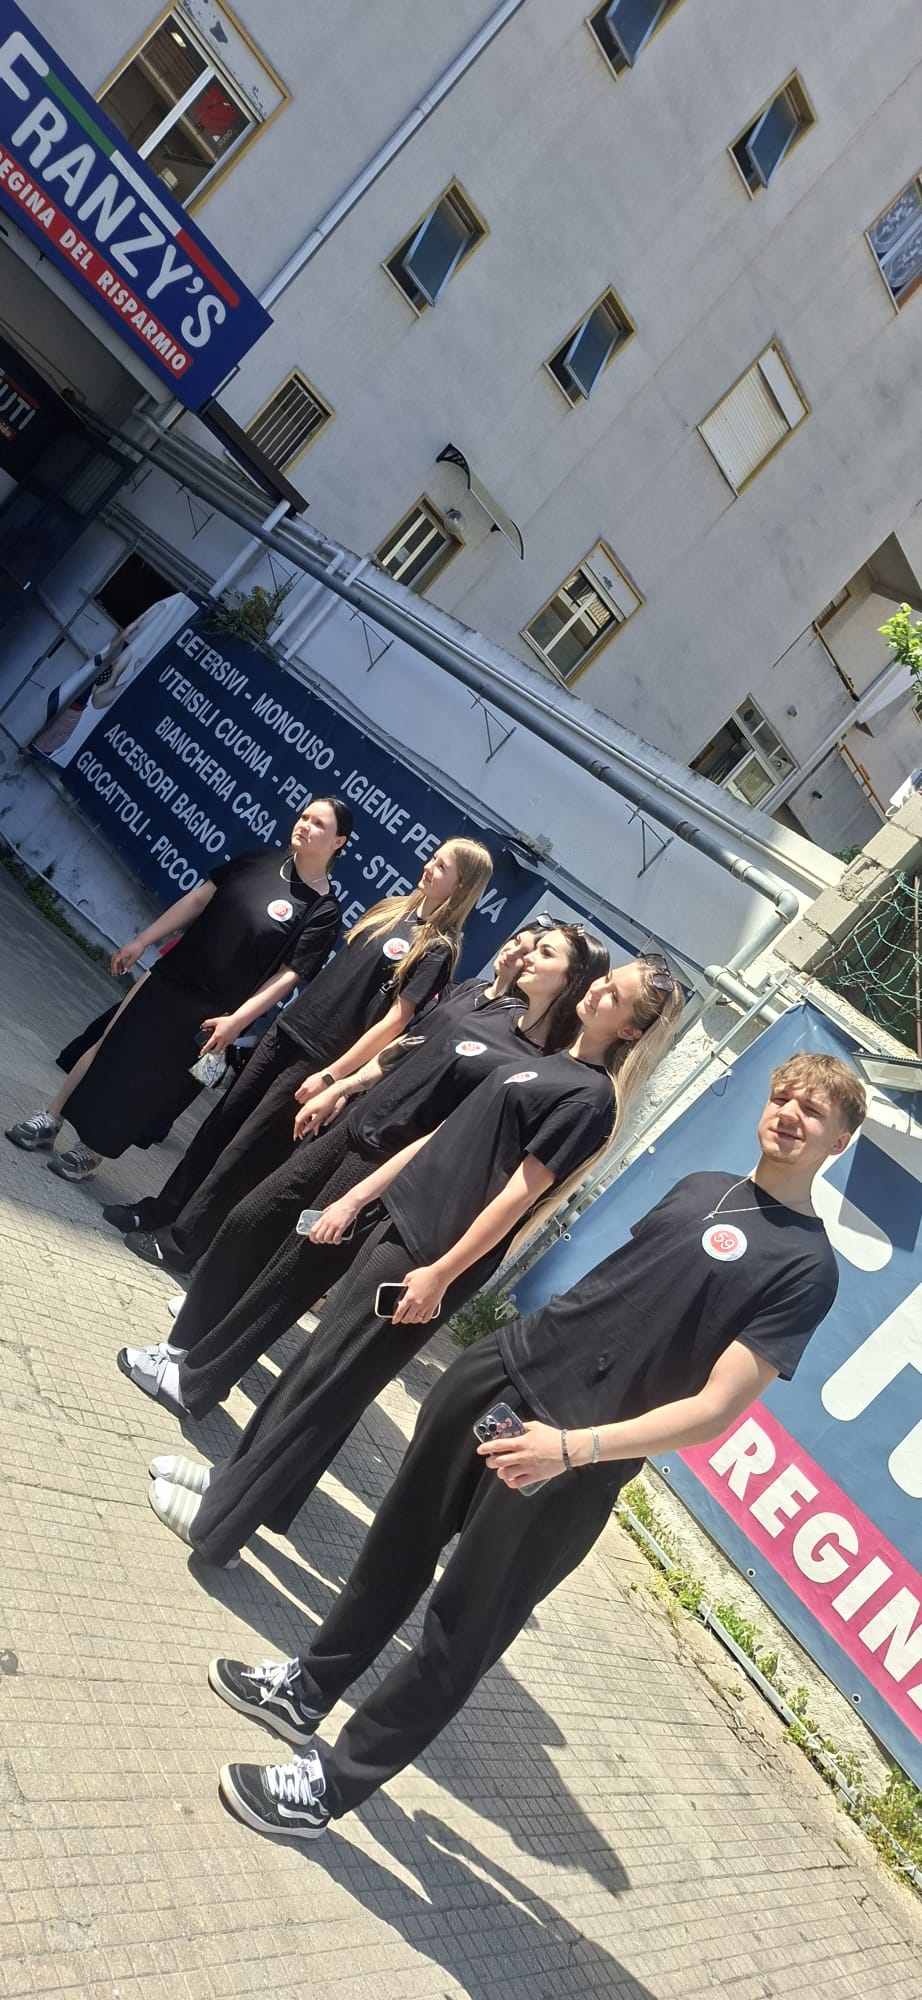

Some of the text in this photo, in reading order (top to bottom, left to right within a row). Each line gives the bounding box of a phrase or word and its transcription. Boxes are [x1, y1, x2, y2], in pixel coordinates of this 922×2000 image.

[0, 31, 227, 348] FRANZY'S
[0, 151, 187, 374] EGINA DEL RISPARMIO
[154, 715, 234, 803] BIANCHERIA
[231, 792, 278, 844] CASA
[158, 664, 220, 728] UTENSILI
[214, 718, 273, 779] CUCINA
[175, 628, 250, 698] DETERSIVI
[251, 692, 335, 770] MONOUSO
[340, 769, 411, 835] IGIENE
[75, 750, 151, 837] GIOCATTOLI
[103, 723, 179, 804] ACCESSORI
[170, 791, 226, 853] BAGNO
[713, 1232, 735, 1250] 59
[708, 1417, 922, 1711] REGIN
